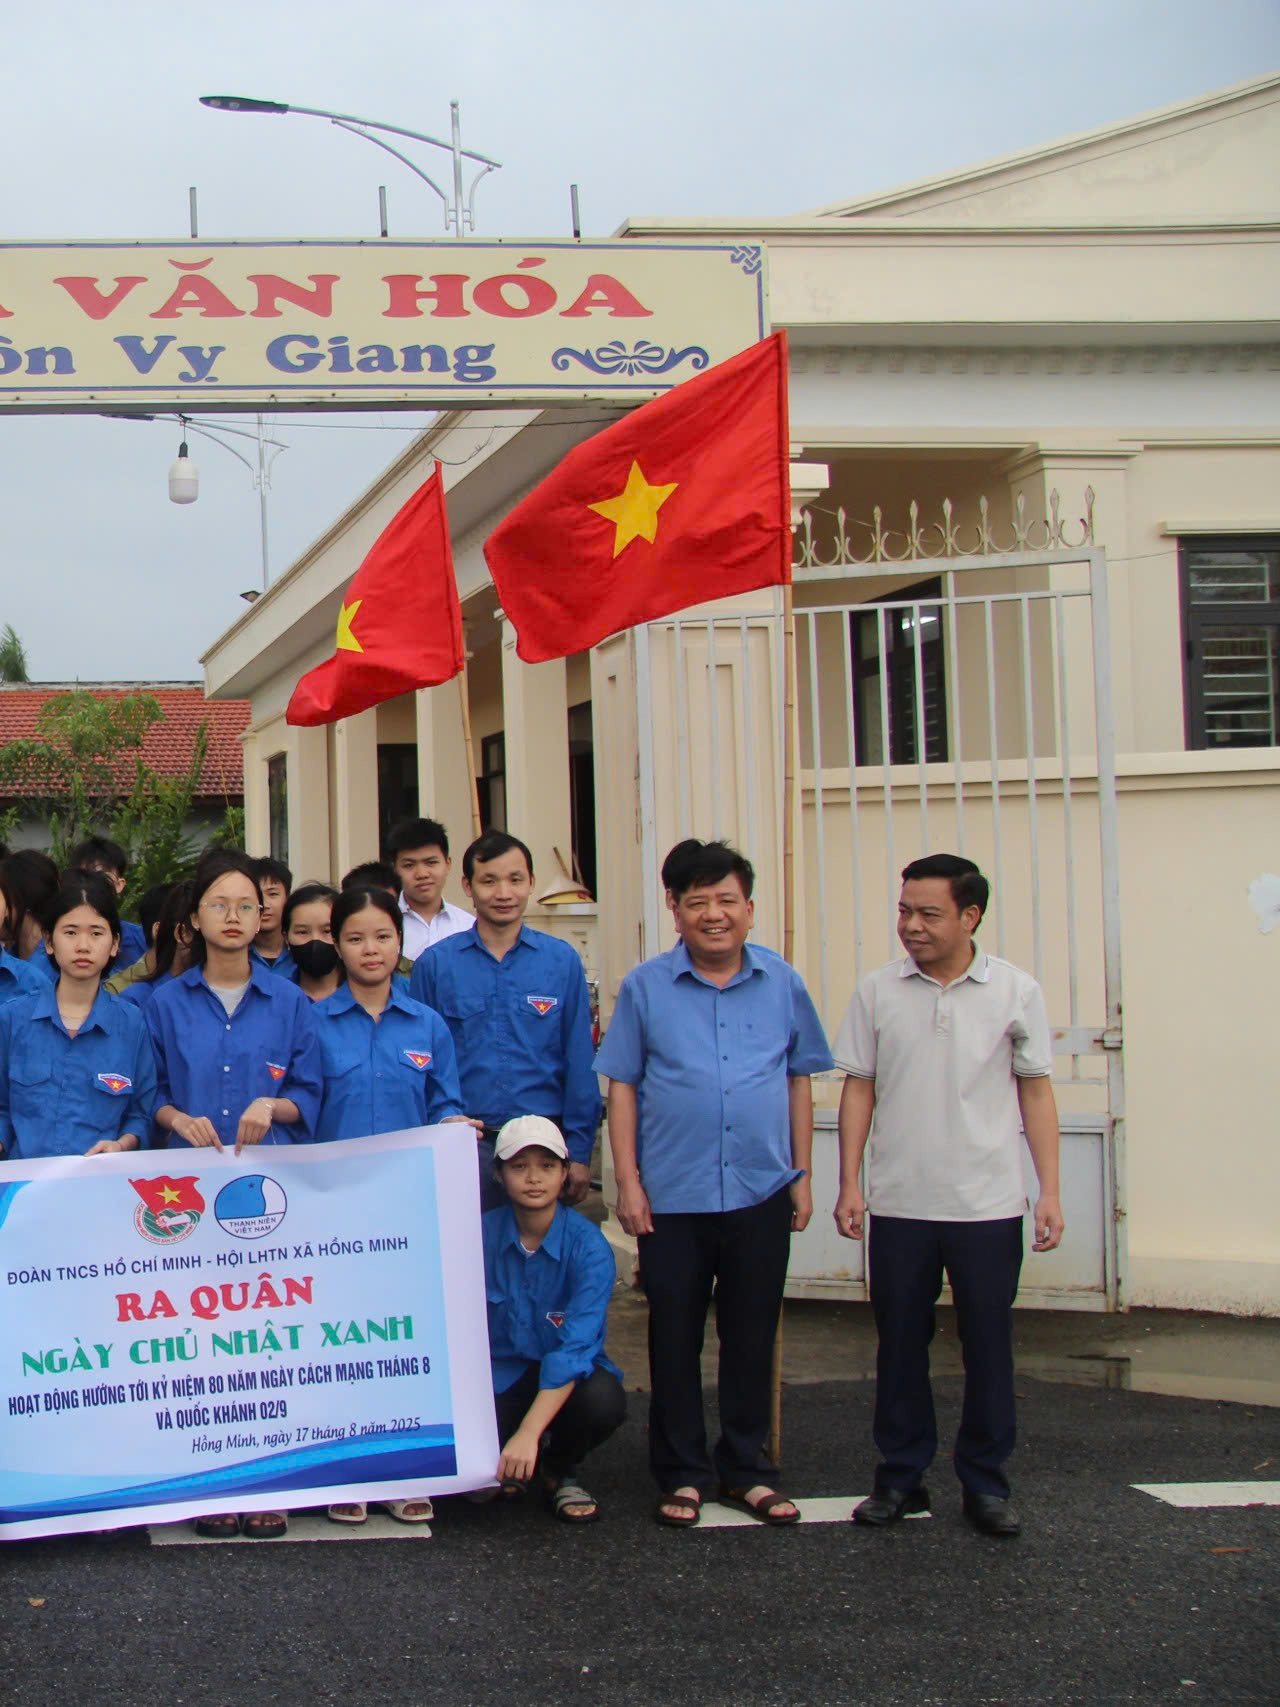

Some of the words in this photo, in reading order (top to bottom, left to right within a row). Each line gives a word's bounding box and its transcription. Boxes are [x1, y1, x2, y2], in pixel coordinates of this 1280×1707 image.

[52, 256, 341, 321] VĂN
[381, 256, 654, 318] HÓA
[265, 334, 498, 382] Giang
[229, 1219, 257, 1228] THANH
[258, 1216, 276, 1225] NIÊN
[7, 1266, 52, 1285] ĐOÀN
[56, 1264, 99, 1281] TNCS
[104, 1256, 127, 1276] HỒ
[131, 1255, 158, 1273] CHÍ
[162, 1255, 202, 1271] MINH
[216, 1249, 244, 1268] HỘI
[248, 1247, 288, 1264] LHTN
[293, 1242, 314, 1259] XÃ
[318, 1236, 364, 1256] HỒNG
[369, 1237, 409, 1252] MINH
[115, 1289, 179, 1322] RA
[190, 1272, 314, 1320] QUÂN
[22, 1337, 113, 1377] NGÀY
[129, 1327, 199, 1365] CHỦ
[211, 1319, 304, 1360] NHẬT
[320, 1315, 414, 1347] XANH
[8, 1394, 40, 1417] HOẠT
[44, 1387, 80, 1414] ĐỘNG
[82, 1382, 126, 1407] HƯỚNG
[128, 1380, 149, 1402] TỚI
[152, 1375, 168, 1400] KỶ
[172, 1374, 206, 1401] NIỆM
[208, 1374, 224, 1395] 80
[228, 1366, 258, 1392] NĂM
[260, 1364, 294, 1389] NGÀY
[298, 1360, 332, 1386] CÁCH
[335, 1360, 374, 1385] MẠNG
[376, 1354, 419, 1378] THÁNG
[422, 1356, 431, 1375] 8
[156, 1409, 173, 1431] VÀ
[176, 1404, 210, 1428] QUỐC
[213, 1399, 257, 1425] KHÁNH
[260, 1399, 288, 1421] 02/9
[191, 1434, 223, 1454] Hồng
[226, 1434, 260, 1450] Minh,
[263, 1430, 293, 1449] ngày
[296, 1426, 309, 1443] 17
[311, 1422, 346, 1444] tháng
[349, 1422, 357, 1436] 8
[360, 1421, 387, 1435] năm
[390, 1416, 421, 1434] 2025
